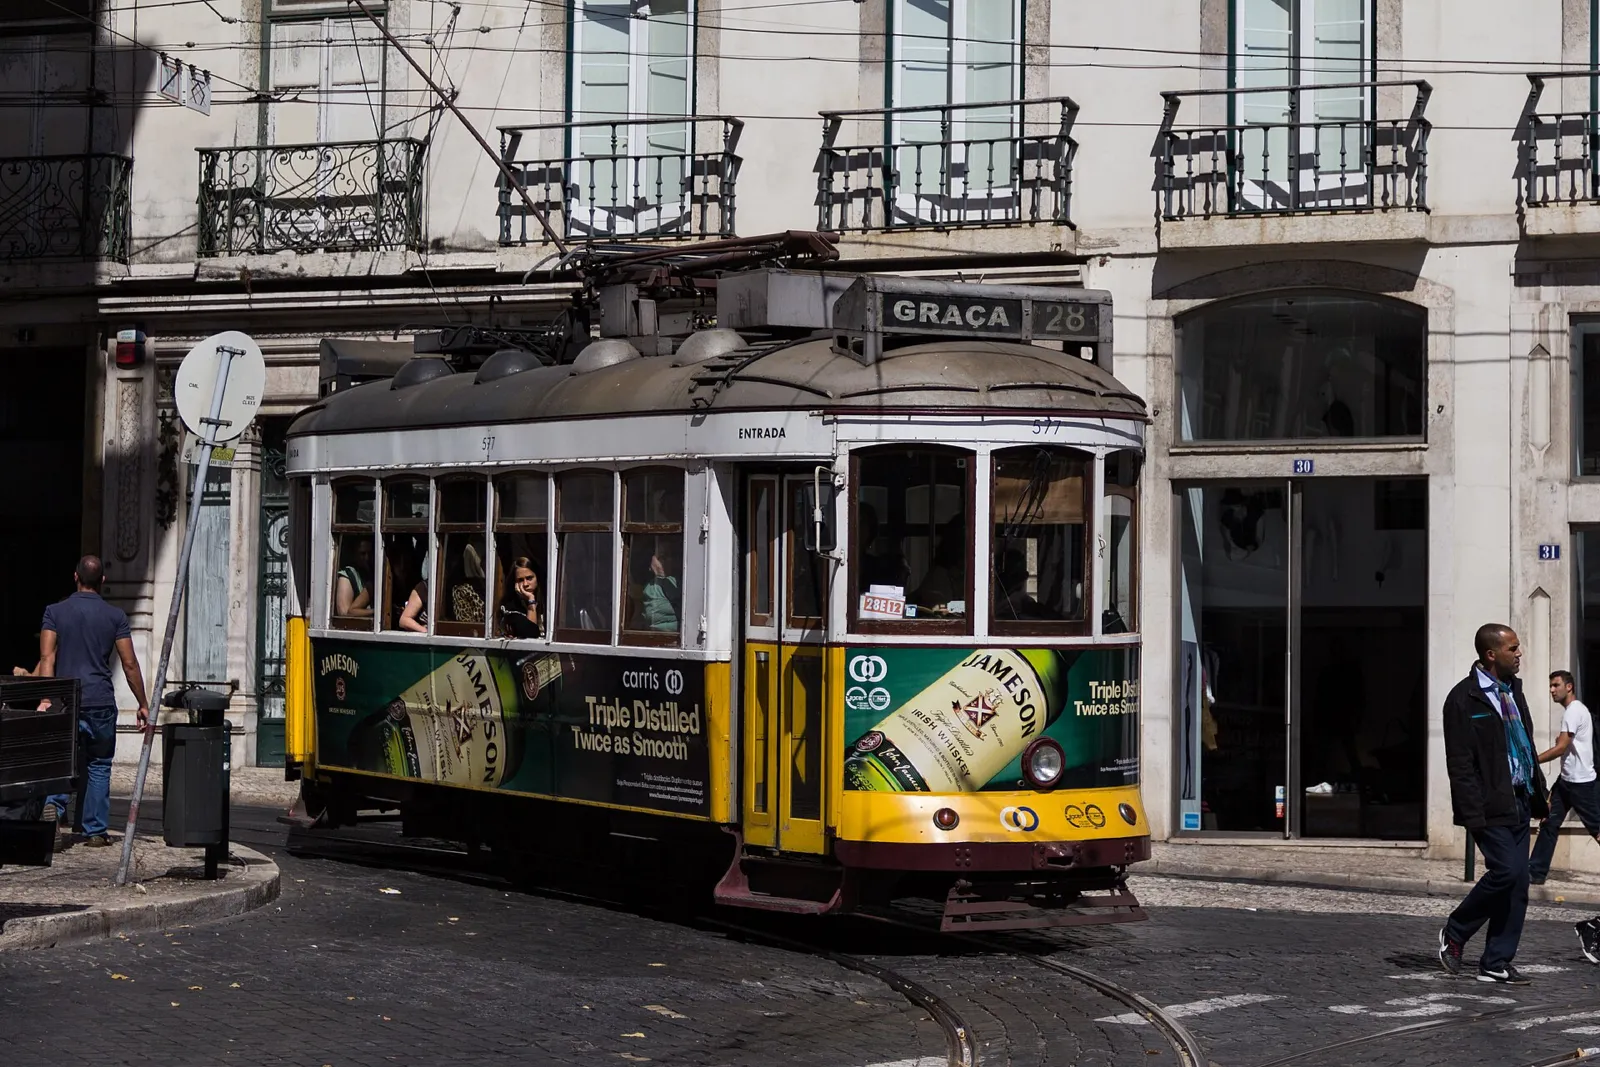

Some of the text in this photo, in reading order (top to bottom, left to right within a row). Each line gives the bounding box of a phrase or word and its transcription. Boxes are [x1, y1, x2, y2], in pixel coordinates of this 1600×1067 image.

[893, 299, 1086, 332] GRAÇA 28
[738, 427, 786, 439] ENTRADA
[1032, 419, 1062, 436] 577
[481, 436, 496, 450] 577
[1296, 460, 1311, 473] 30
[1542, 545, 1556, 559] 31
[865, 598, 902, 614] 28E 12
[320, 653, 358, 678] JAMESON
[622, 665, 660, 691] carris
[961, 653, 1036, 740] JAMESON
[1088, 680, 1121, 704] Triple
[456, 652, 498, 783] JAMESON
[584, 695, 701, 735] Triple Distilled
[1073, 700, 1108, 716] Twice
[1109, 702, 1120, 715] as
[570, 725, 612, 753] Twice
[613, 734, 631, 755] as
[911, 708, 938, 731] IRISH
[937, 730, 971, 777] WHISKEY
[878, 744, 904, 768] John
